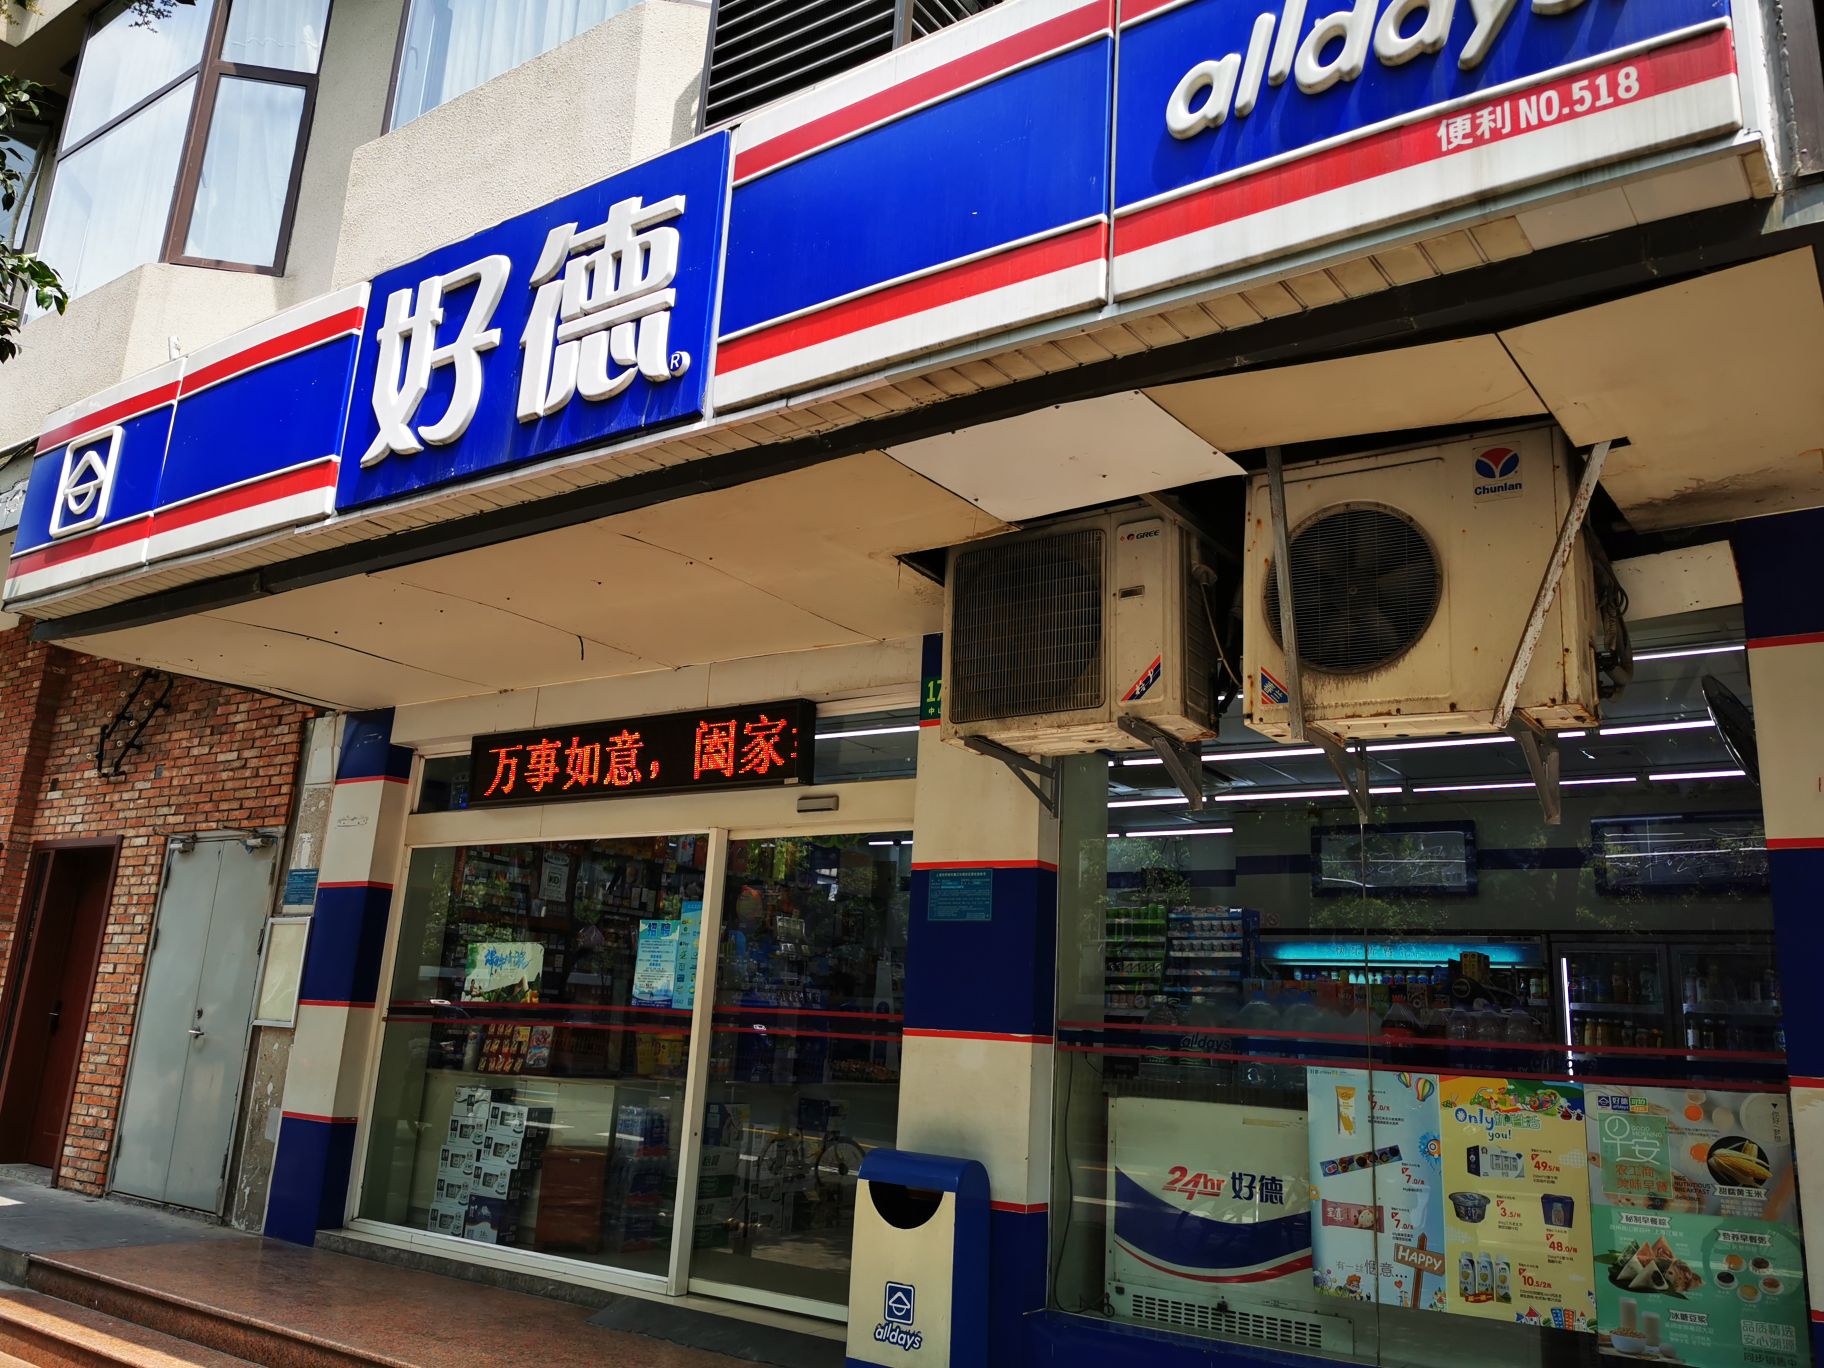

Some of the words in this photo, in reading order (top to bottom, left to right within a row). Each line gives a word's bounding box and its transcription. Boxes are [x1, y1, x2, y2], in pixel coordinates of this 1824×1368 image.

[1166, 0, 1585, 140] allday
[1437, 101, 1511, 152] 便利
[1518, 66, 1641, 129] NO.518
[360, 195, 685, 467] 好德
[1474, 482, 1523, 496] Chunlan
[1136, 529, 1160, 540] GREE
[1180, 1033, 1233, 1051] alldays
[1455, 1107, 1495, 1131] Only
[1488, 1129, 1512, 1141] you!
[1161, 1165, 1225, 1201] 24hr
[1231, 1171, 1285, 1205] 好德
[1398, 1246, 1443, 1271] HAPPY
[873, 1323, 923, 1352] alldays
